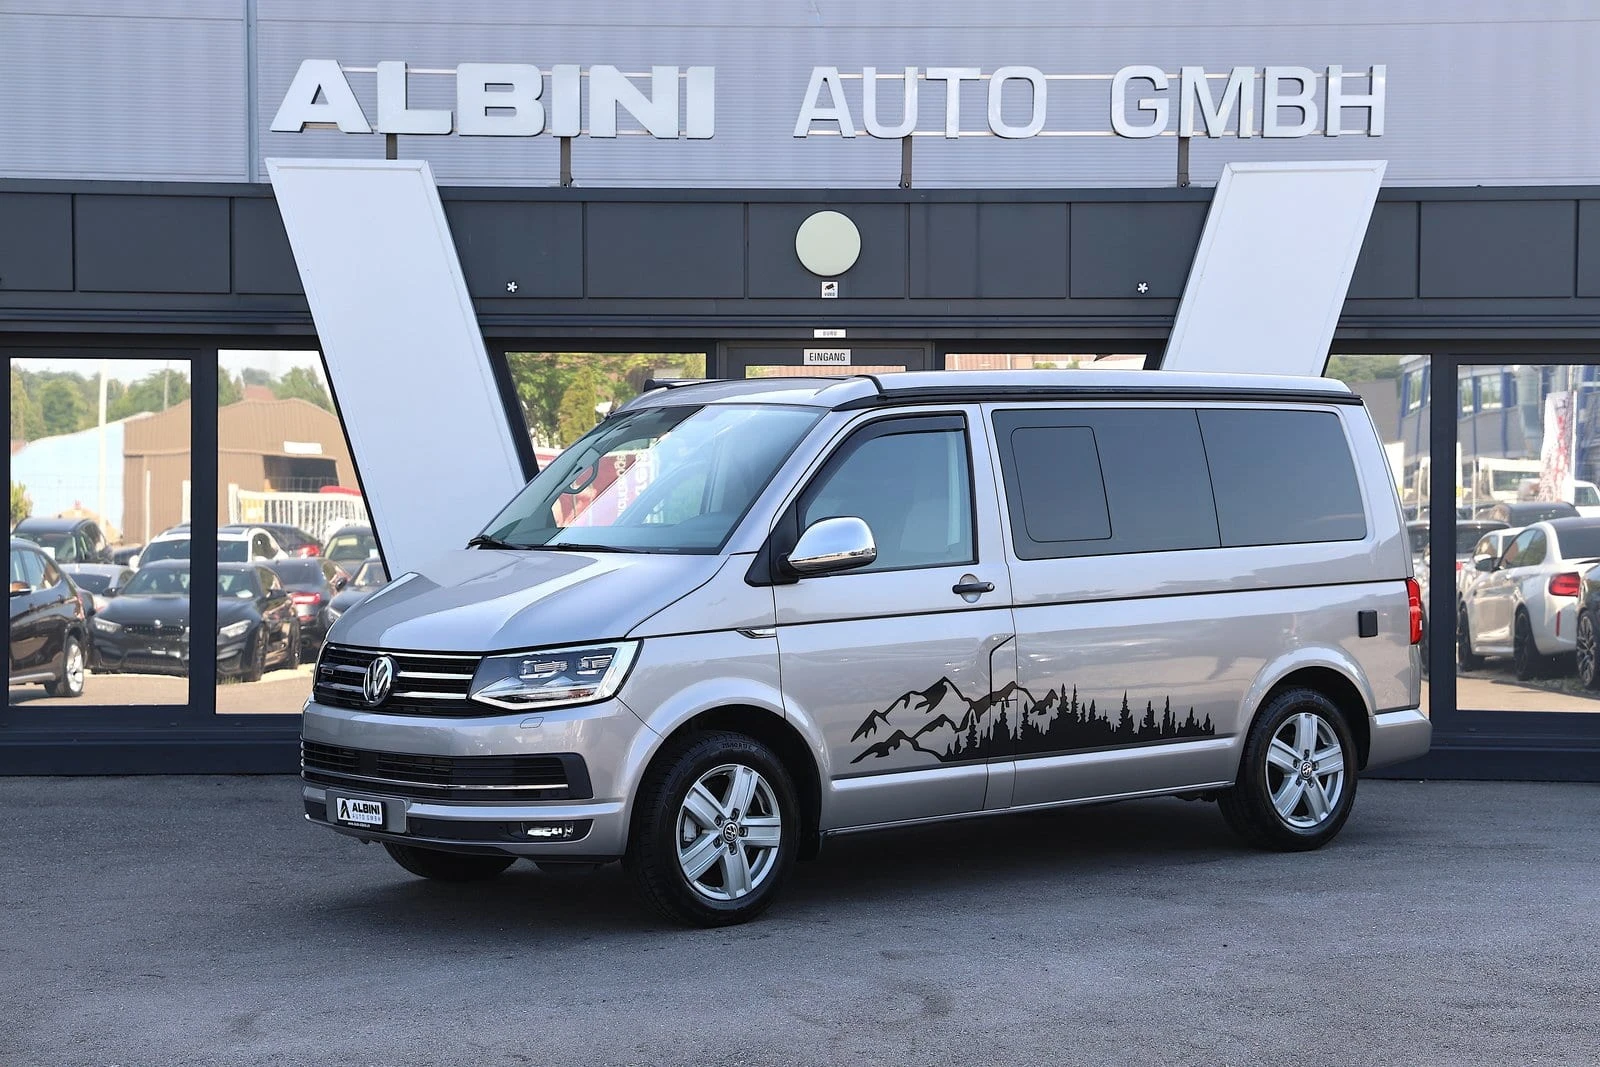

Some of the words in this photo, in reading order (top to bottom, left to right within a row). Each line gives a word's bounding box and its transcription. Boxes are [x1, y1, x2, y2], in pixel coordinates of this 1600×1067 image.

[269, 58, 716, 139] ALBINI
[793, 65, 1048, 139] AUTO
[1111, 64, 1387, 138] GMBH
[809, 352, 846, 362] EINGANG
[352, 802, 380, 815] ALBINI
